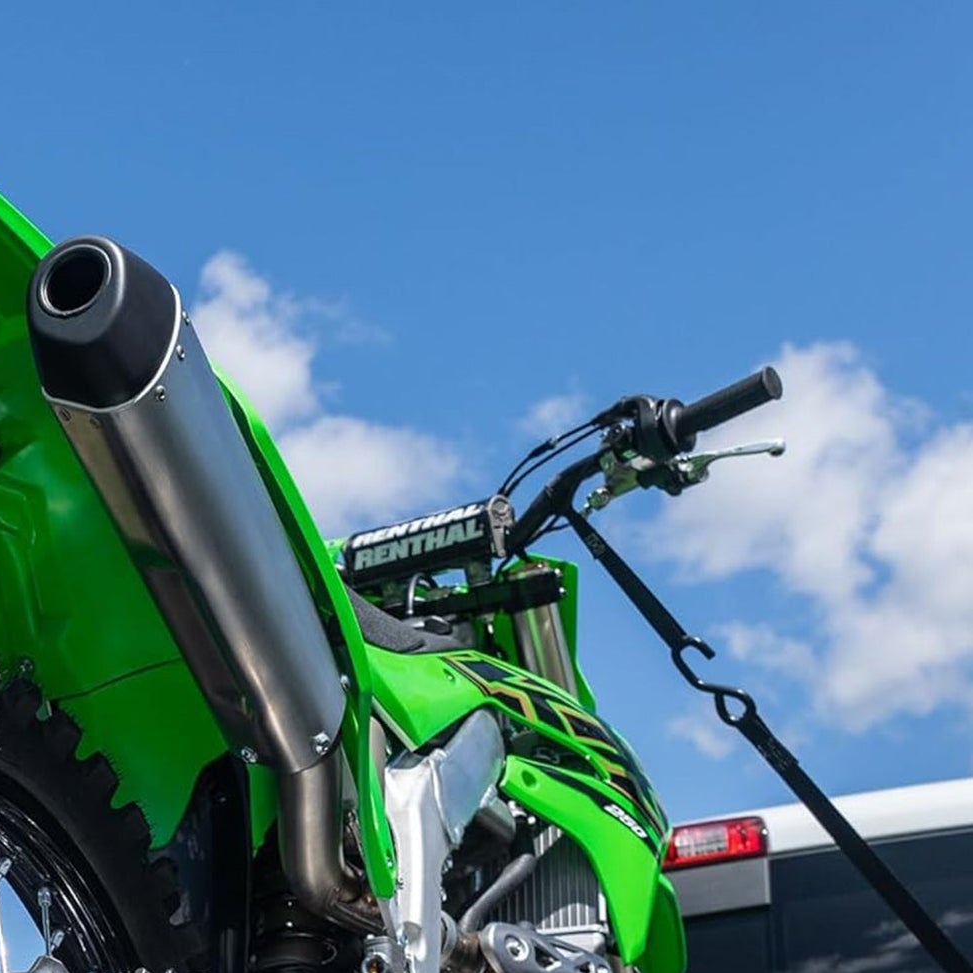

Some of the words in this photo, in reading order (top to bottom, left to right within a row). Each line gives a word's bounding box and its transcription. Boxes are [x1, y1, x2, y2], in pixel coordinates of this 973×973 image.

[352, 503, 485, 548] RENTHAL
[354, 518, 484, 571] RENTHAL
[604, 804, 648, 839] 250
